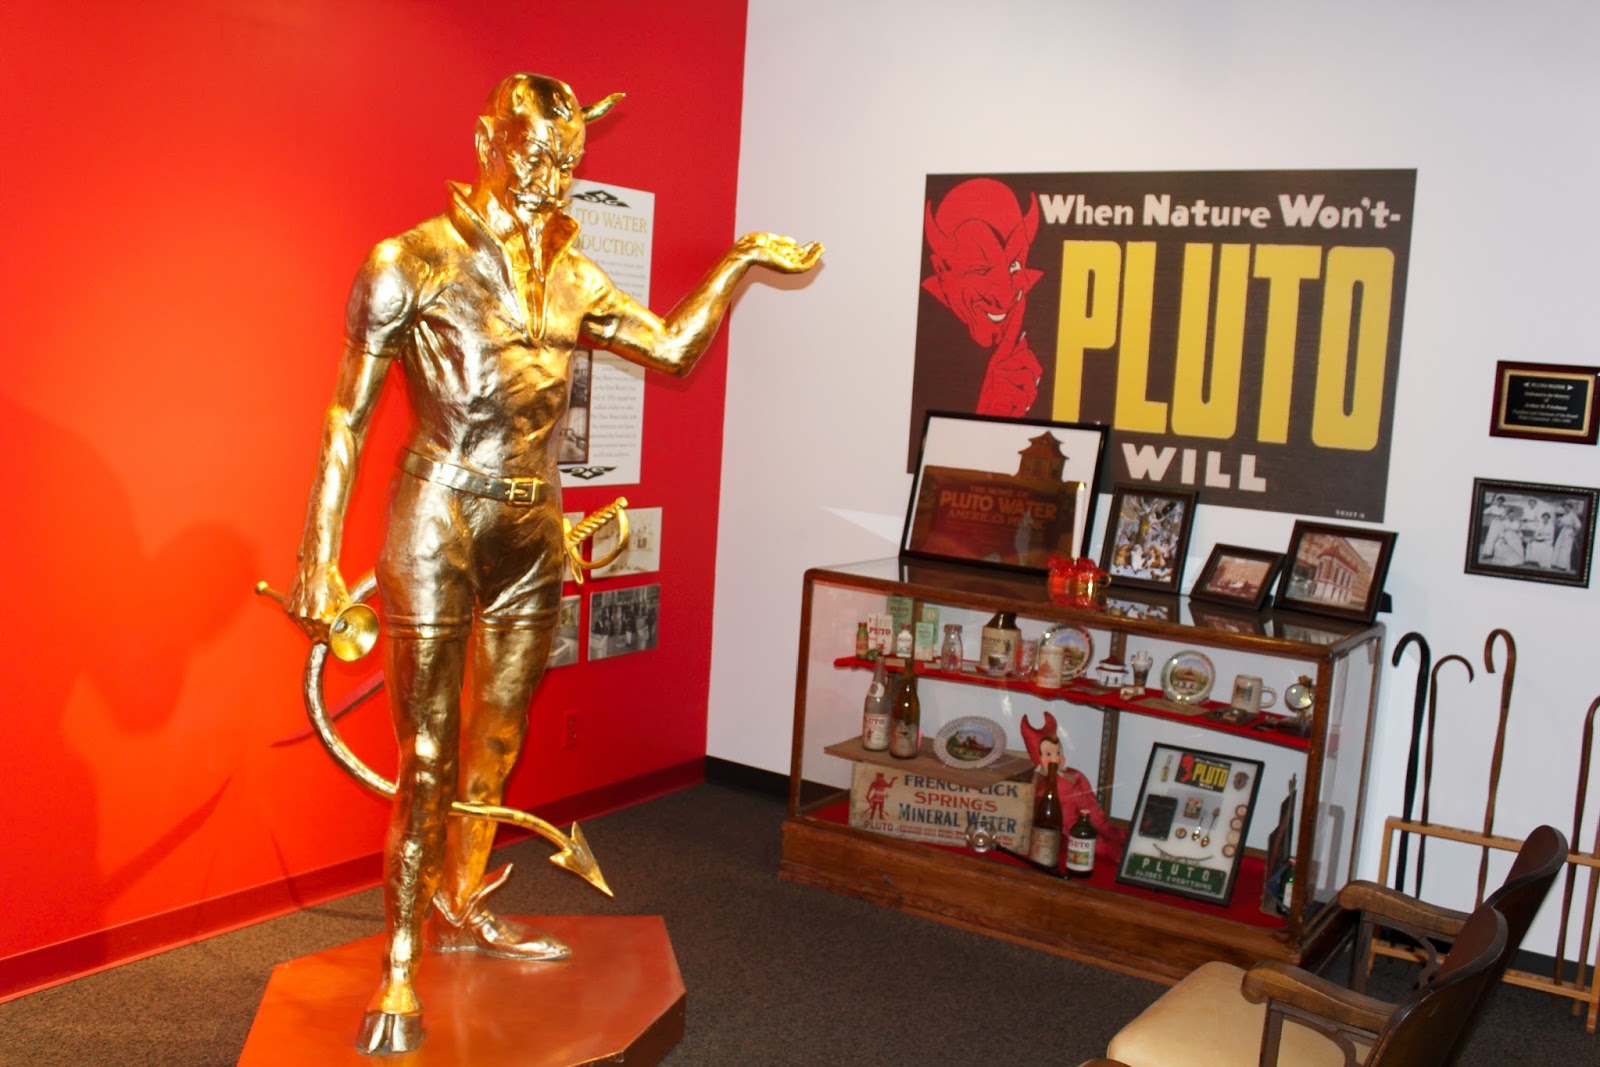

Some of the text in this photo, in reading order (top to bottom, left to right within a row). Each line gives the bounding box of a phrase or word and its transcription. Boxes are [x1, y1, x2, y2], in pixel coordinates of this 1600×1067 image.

[602, 211, 647, 234] WATER
[1039, 194, 1134, 226] When
[1142, 194, 1271, 228] Nature
[571, 233, 645, 257] ODUCTION
[1052, 239, 1395, 451] PLUTO
[1121, 443, 1266, 492] WILL
[939, 490, 1057, 519] PLUTO WATER
[868, 626, 891, 636] PLUTO
[1192, 762, 1229, 788] PLUTO
[914, 791, 998, 812] SPRINGS
[864, 820, 894, 832] PLUTO
[899, 803, 961, 827] MINERAL
[966, 811, 1017, 833] WATER
[1142, 857, 1210, 881] PLUTO
